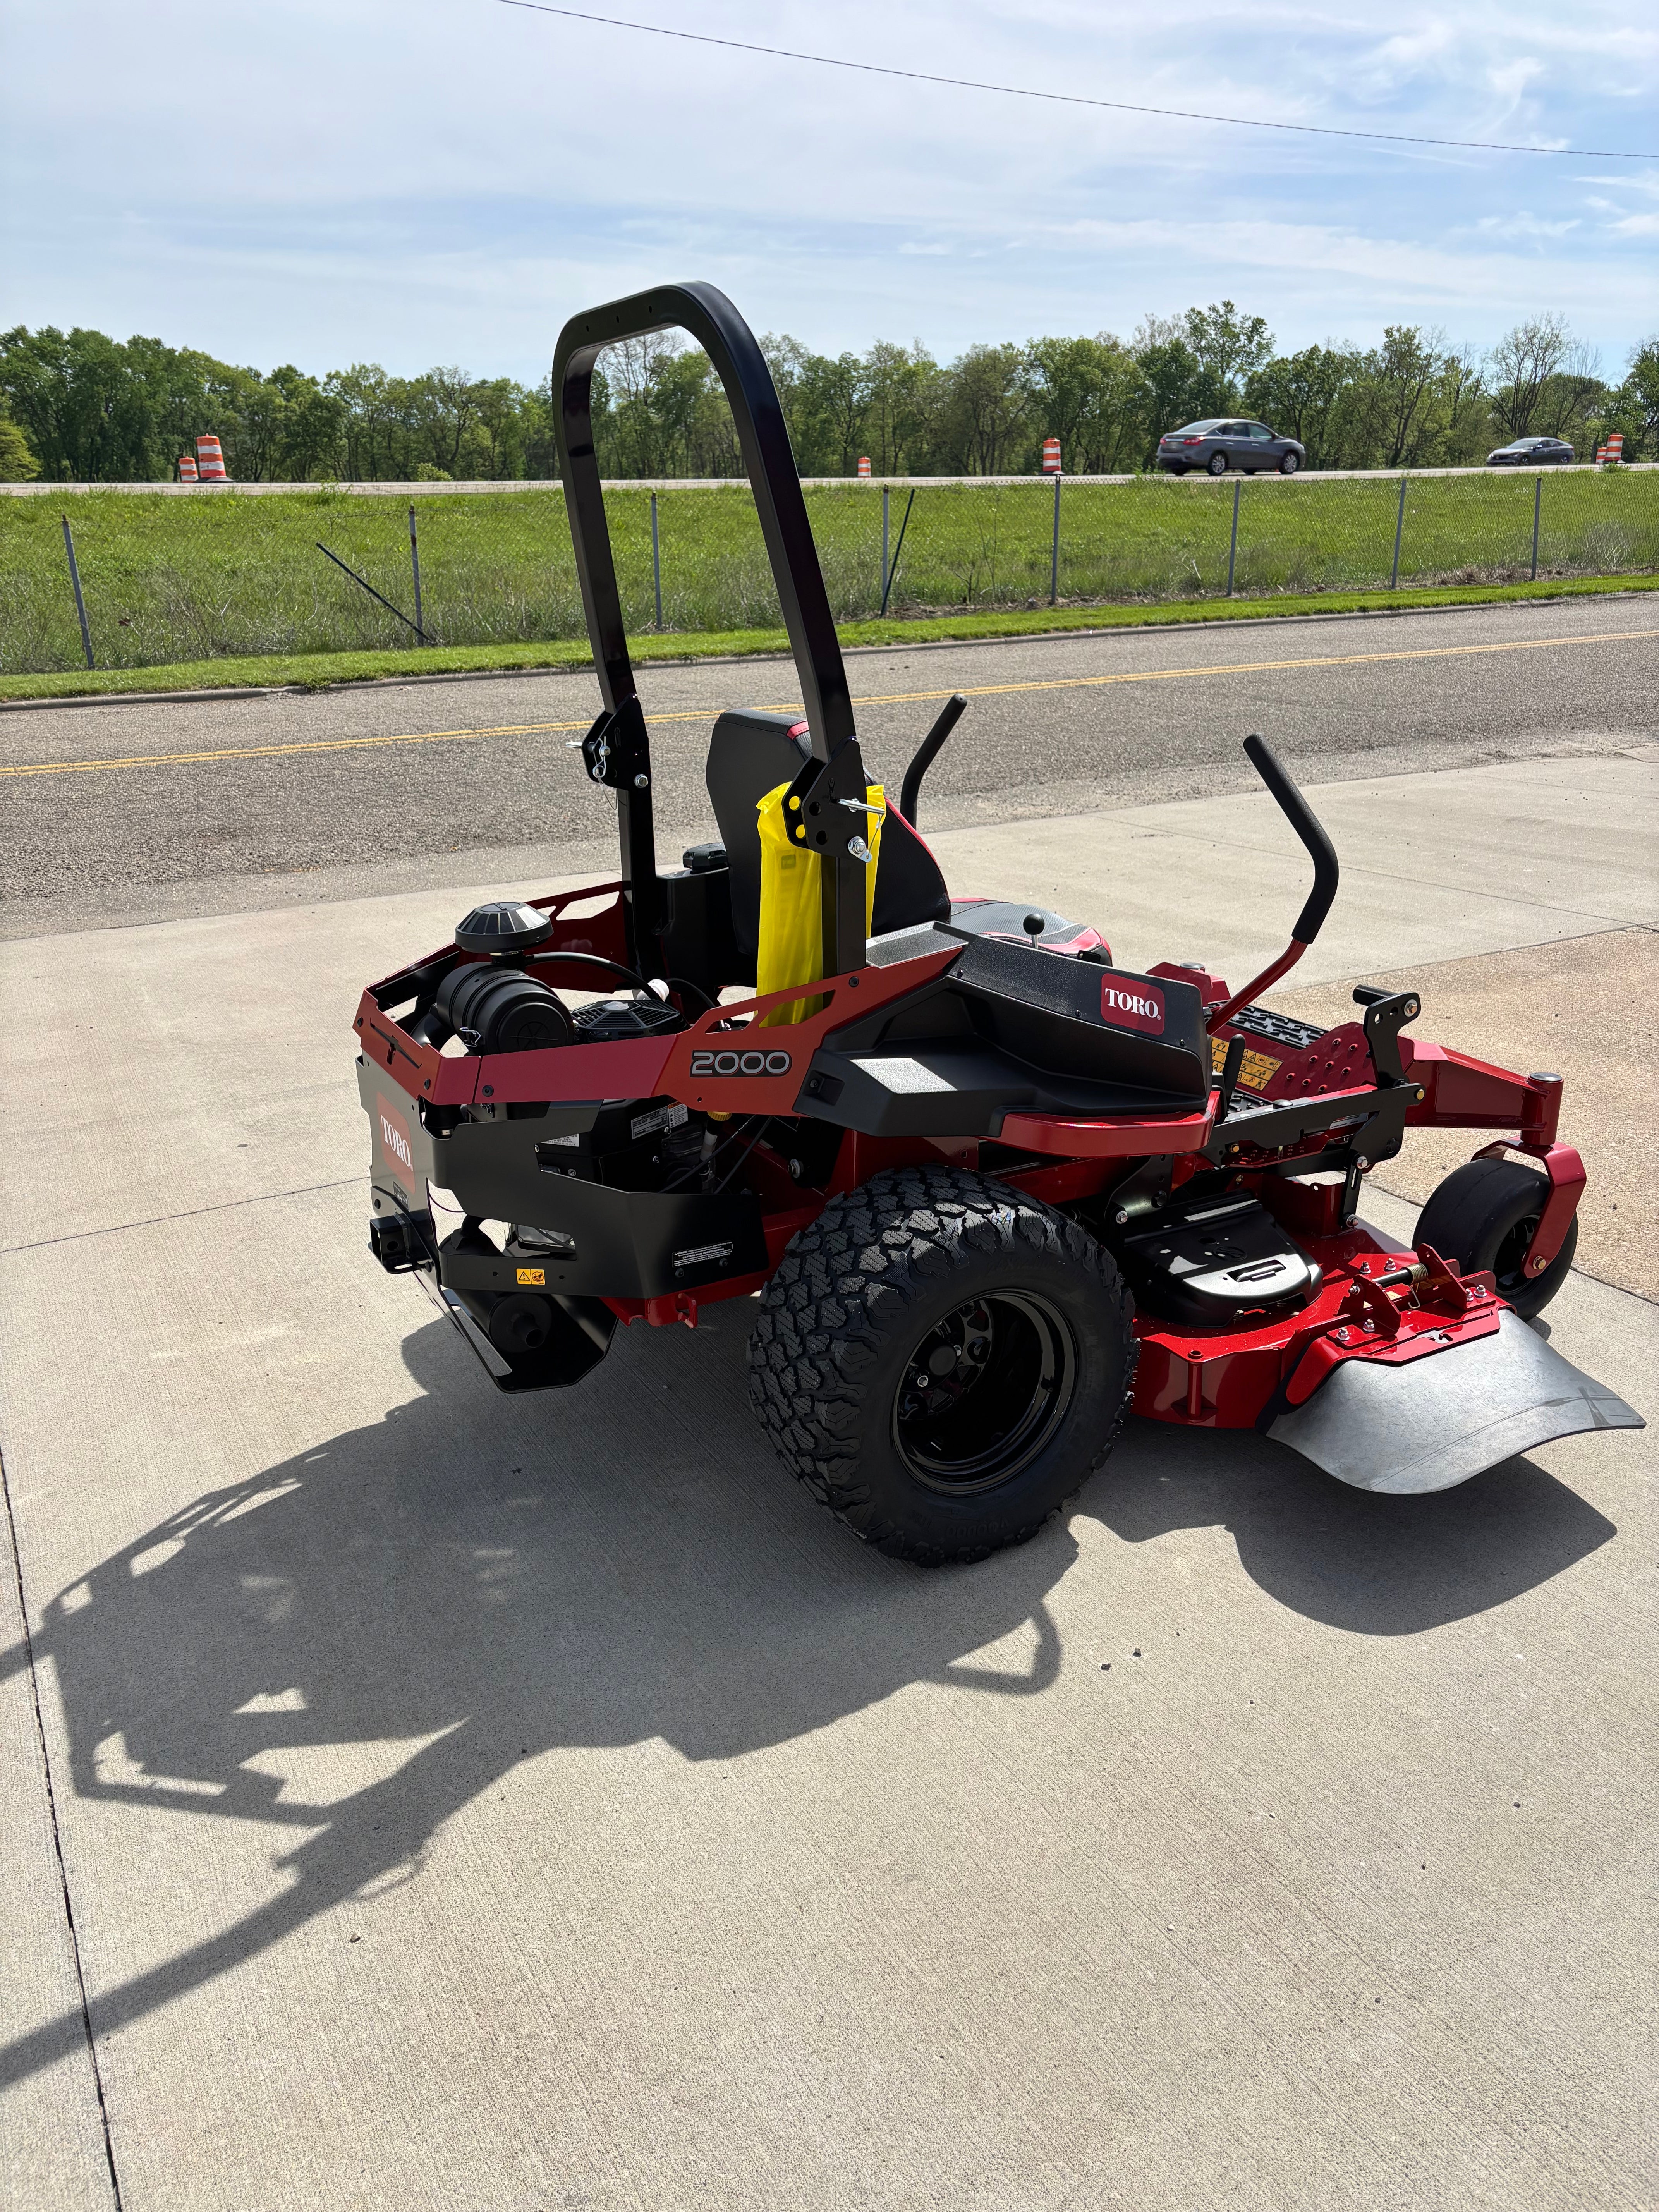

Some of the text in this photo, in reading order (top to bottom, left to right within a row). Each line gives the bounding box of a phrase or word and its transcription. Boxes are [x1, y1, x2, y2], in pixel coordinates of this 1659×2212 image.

[1105, 988, 1159, 1018] TORO
[692, 1051, 790, 1075] 2000
[381, 1115, 411, 1167] TORO
